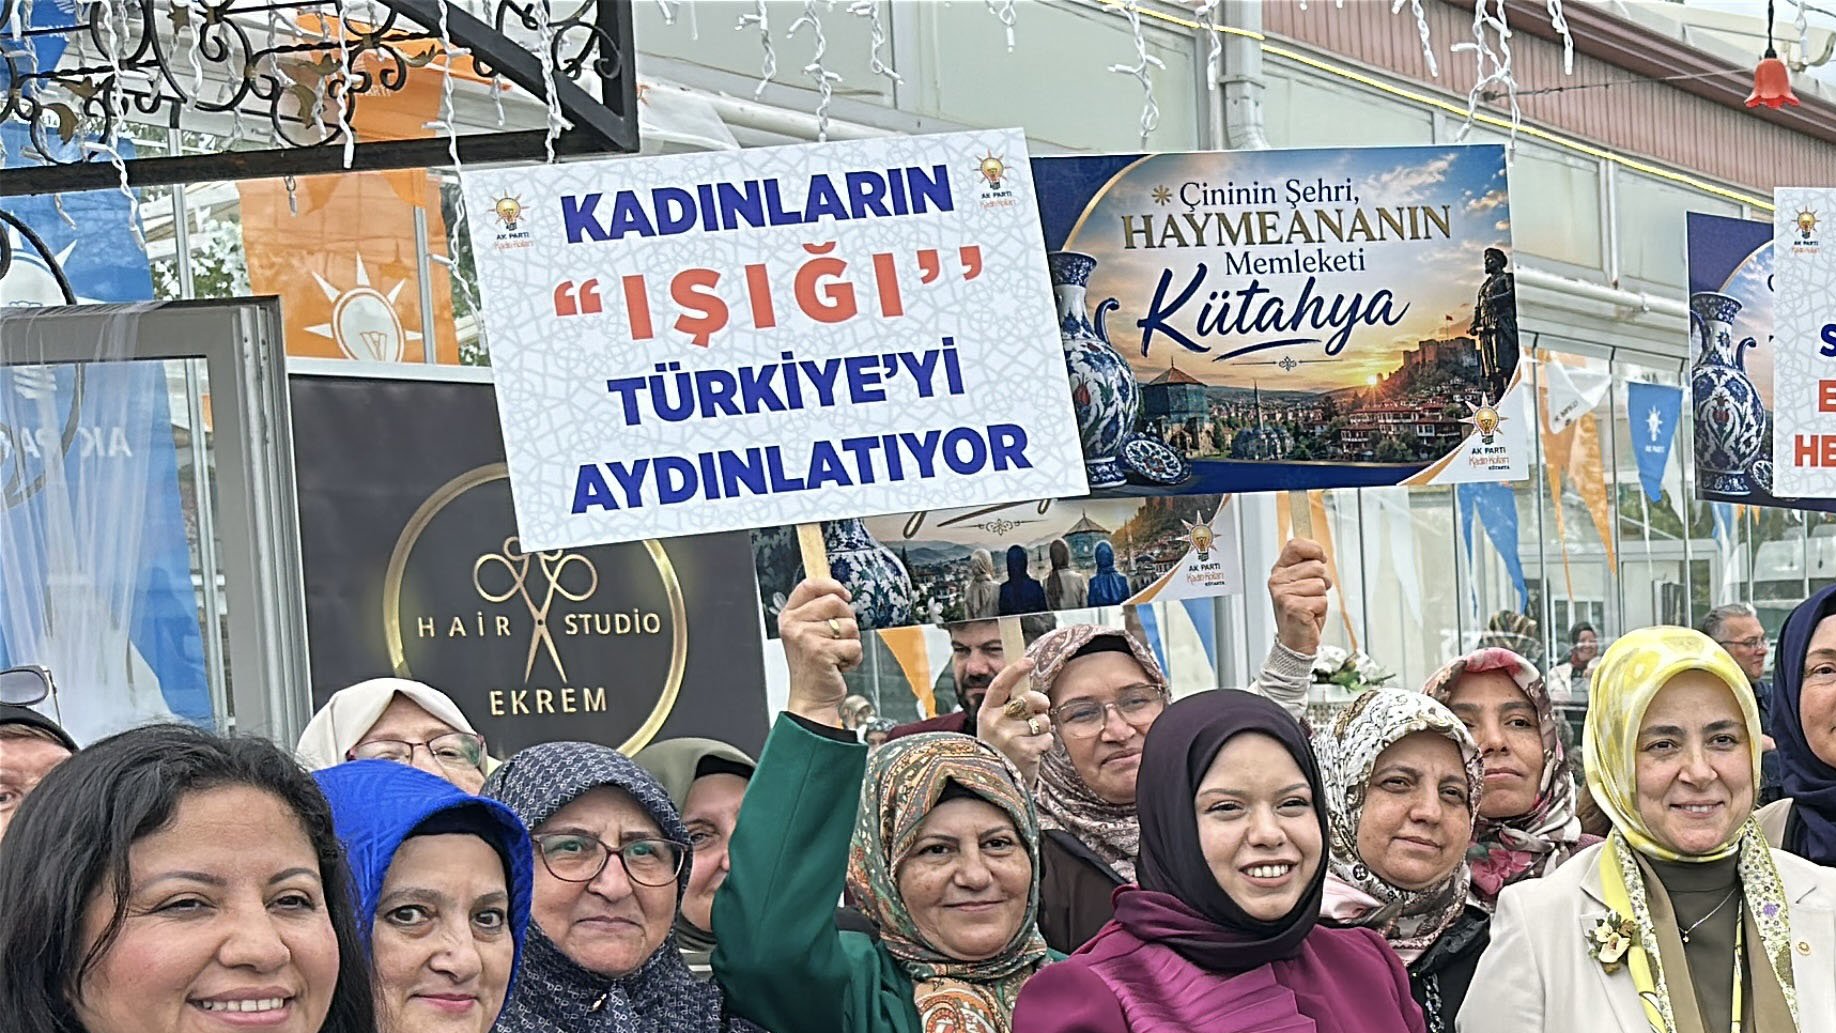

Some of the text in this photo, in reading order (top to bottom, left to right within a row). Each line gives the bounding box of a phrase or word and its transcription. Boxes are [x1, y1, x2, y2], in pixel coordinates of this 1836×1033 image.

[560, 164, 955, 244] KADINLARIN
[1179, 178, 1360, 213] Çininin Şehri,
[1120, 204, 1452, 250] HAYMEANANIN
[1225, 248, 1366, 276] Memleketi
[1136, 262, 1411, 358] Kütahya
[571, 424, 1033, 515] AYDINLATIYOR
[489, 687, 608, 716] EKREM
